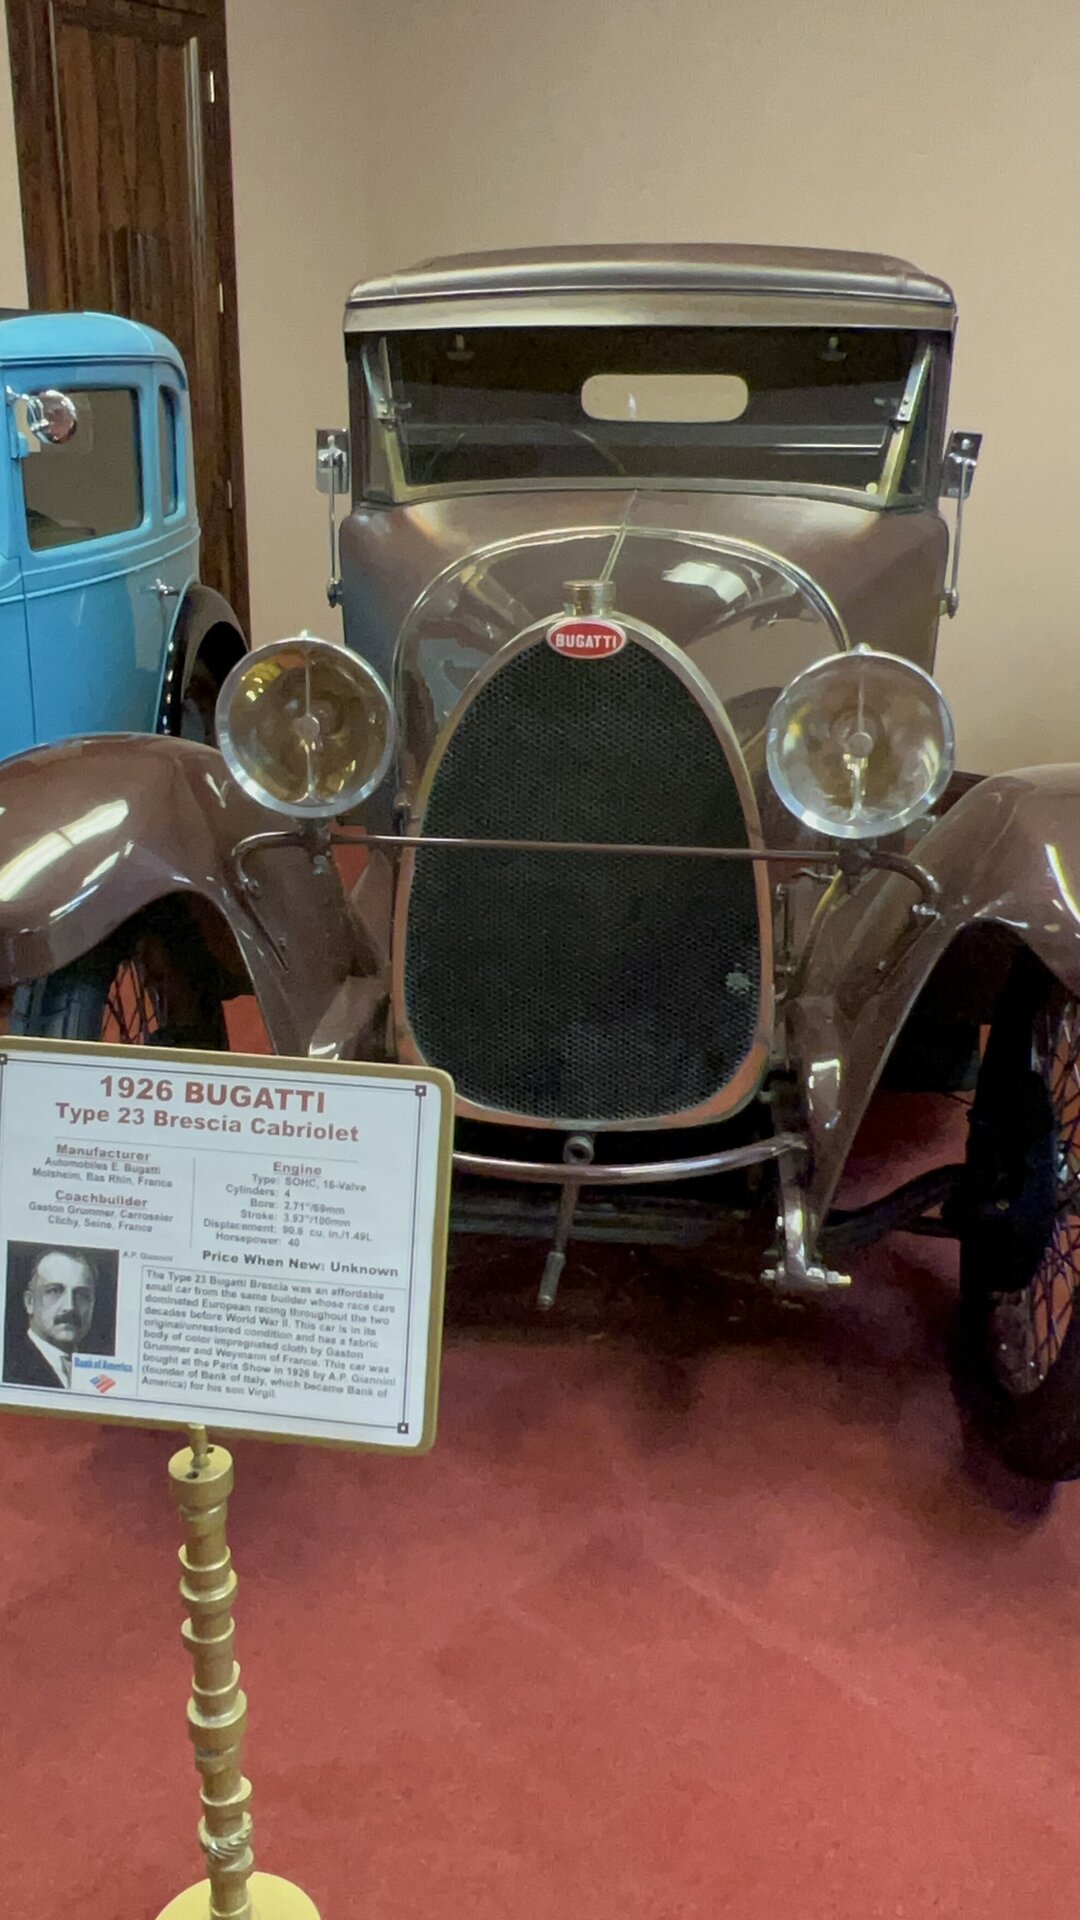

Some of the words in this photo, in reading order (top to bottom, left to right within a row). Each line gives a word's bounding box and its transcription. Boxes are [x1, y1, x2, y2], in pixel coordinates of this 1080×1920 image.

[556, 634, 617, 648] BUGATTI
[100, 1075, 173, 1102] 1926
[185, 1081, 326, 1114] BUGATTI
[55, 1102, 110, 1125] Type
[118, 1107, 146, 1125] 23
[154, 1112, 241, 1133] Brescia
[250, 1118, 359, 1142] Cabriolet
[56, 1144, 151, 1161] Manufacturer
[45, 1157, 108, 1170] Automobiles
[124, 1164, 161, 1175] Bugatti
[273, 1162, 322, 1176] Engine
[32, 1168, 82, 1181] Molsheim,
[86, 1172, 105, 1182] Bas
[109, 1173, 134, 1186] Rhin,
[138, 1176, 173, 1187] France
[252, 1174, 279, 1185] Type:
[285, 1177, 319, 1189] SOHC,
[323, 1180, 366, 1192] 16-Valve
[55, 1189, 148, 1207] Coachbuilder
[226, 1184, 278, 1197] Cylinders:
[29, 1201, 64, 1213] Gaston
[68, 1205, 117, 1218] Grummer,
[120, 1210, 173, 1222] Carrossier
[250, 1198, 277, 1209] Bore:
[48, 1216, 80, 1228] Clichy,
[84, 1218, 115, 1230] Seine,
[118, 1221, 152, 1232] France
[241, 1209, 277, 1221] Stroke:
[204, 1218, 276, 1233] Displacement:
[310, 1229, 324, 1237] cu.
[216, 1232, 281, 1246] Horsepower:
[288, 1238, 300, 1247] 40
[203, 1250, 238, 1263] Price
[244, 1254, 284, 1267] When
[289, 1258, 325, 1271] New:
[331, 1261, 398, 1277] Unknown
[147, 1270, 165, 1280] The
[169, 1272, 191, 1283] Type
[195, 1275, 206, 1283] 23
[210, 1276, 246, 1287] Bugatti
[250, 1280, 288, 1291] Brescia
[315, 1287, 328, 1295] an
[331, 1288, 384, 1300] affordable
[146, 1283, 172, 1292] small
[195, 1287, 218, 1296] from
[221, 1289, 237, 1298] the
[241, 1293, 267, 1301] same
[271, 1294, 307, 1304] builder
[310, 1298, 343, 1308] whose
[347, 1302, 369, 1310] race
[373, 1304, 395, 1313] cars
[145, 1294, 198, 1307] dominated
[202, 1299, 250, 1312] European
[255, 1306, 286, 1317] racing
[290, 1308, 347, 1321] throughout
[351, 1314, 367, 1322] the
[371, 1316, 390, 1324] two
[145, 1307, 186, 1317] decades
[190, 1310, 222, 1320] before
[226, 1313, 256, 1324] World
[259, 1316, 279, 1326] War
[295, 1320, 315, 1330] This
[319, 1323, 335, 1331] car
[339, 1325, 347, 1333] is
[351, 1326, 360, 1334] in
[364, 1327, 376, 1336] its
[144, 1330, 168, 1340] body
[185, 1335, 210, 1343] color
[214, 1338, 278, 1350] impregnated
[281, 1344, 307, 1354] cloth
[311, 1346, 322, 1357] by
[326, 1347, 363, 1358] Gaston
[244, 1328, 292, 1338] condition
[296, 1333, 315, 1342] and
[318, 1335, 336, 1344] has
[349, 1338, 378, 1348] fabric
[144, 1341, 191, 1353] Grummer
[194, 1347, 212, 1355] and
[216, 1348, 266, 1360] Weymann
[283, 1355, 319, 1366] France.
[324, 1359, 345, 1369] This
[143, 1354, 178, 1365] bought
[194, 1358, 209, 1367] the
[213, 1360, 238, 1370] Paris
[242, 1362, 271, 1372] Show
[288, 1367, 310, 1377] 1926
[313, 1370, 325, 1380] by
[352, 1374, 396, 1385] Giannini
[142, 1365, 184, 1376] (founder
[201, 1371, 226, 1380] Bank
[244, 1375, 267, 1386] Italy,
[271, 1379, 300, 1388] which
[304, 1382, 343, 1393] became
[347, 1386, 373, 1396] Bank
[377, 1389, 387, 1397] of
[142, 1376, 187, 1389] America)
[190, 1382, 204, 1390] for
[207, 1383, 221, 1392] his
[226, 1386, 244, 1394] son
[248, 1387, 276, 1399] Virgil.
